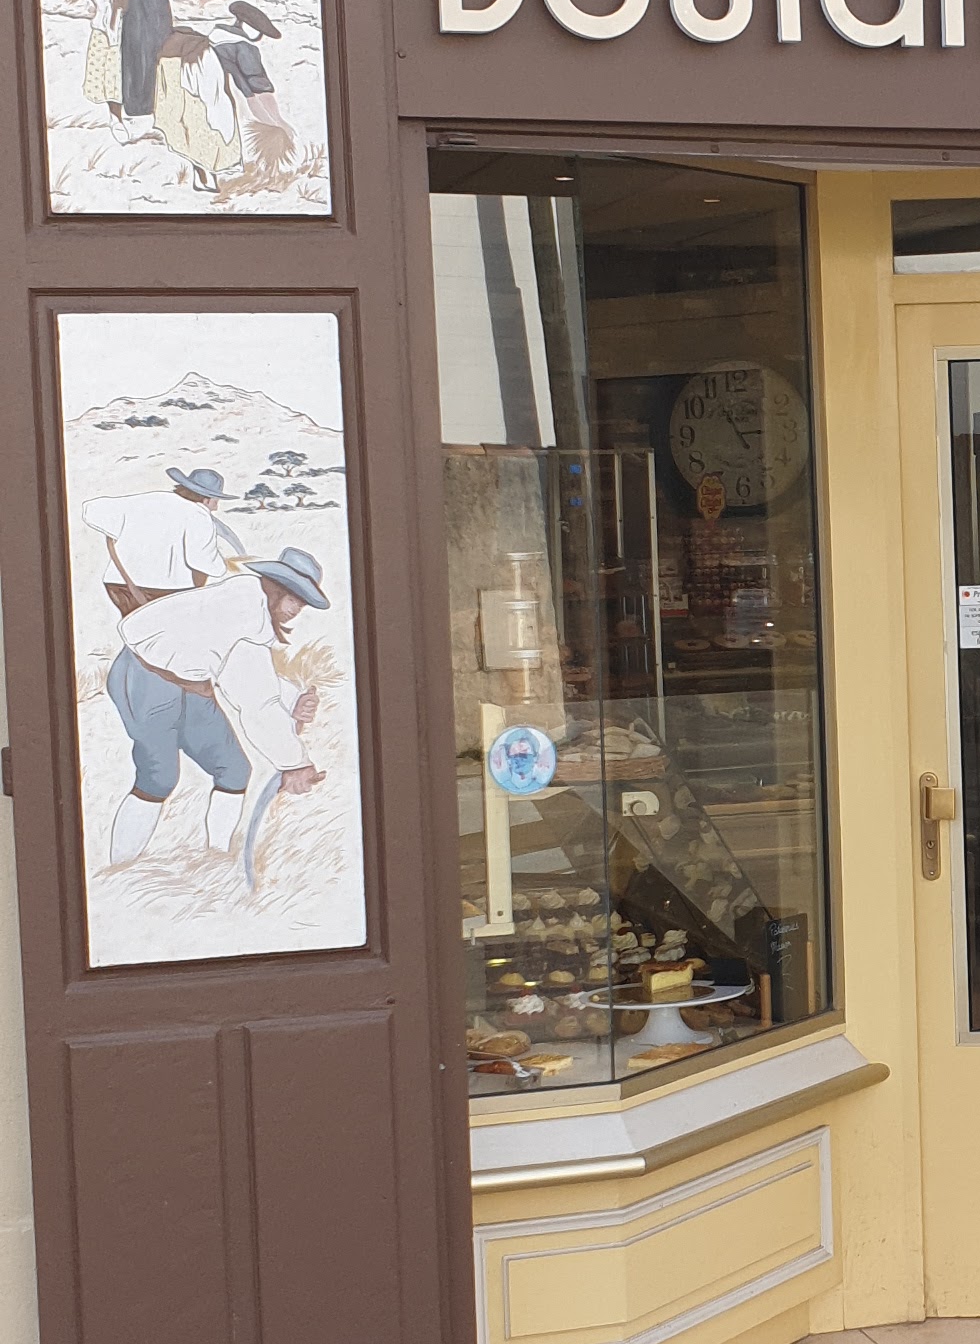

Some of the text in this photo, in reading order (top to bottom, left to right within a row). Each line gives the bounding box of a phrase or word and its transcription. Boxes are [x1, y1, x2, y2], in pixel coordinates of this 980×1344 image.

[725, 369, 748, 393] 12
[684, 396, 705, 420] 10
[679, 424, 696, 448] 9
[688, 450, 706, 475] 8
[735, 475, 751, 499] 6
